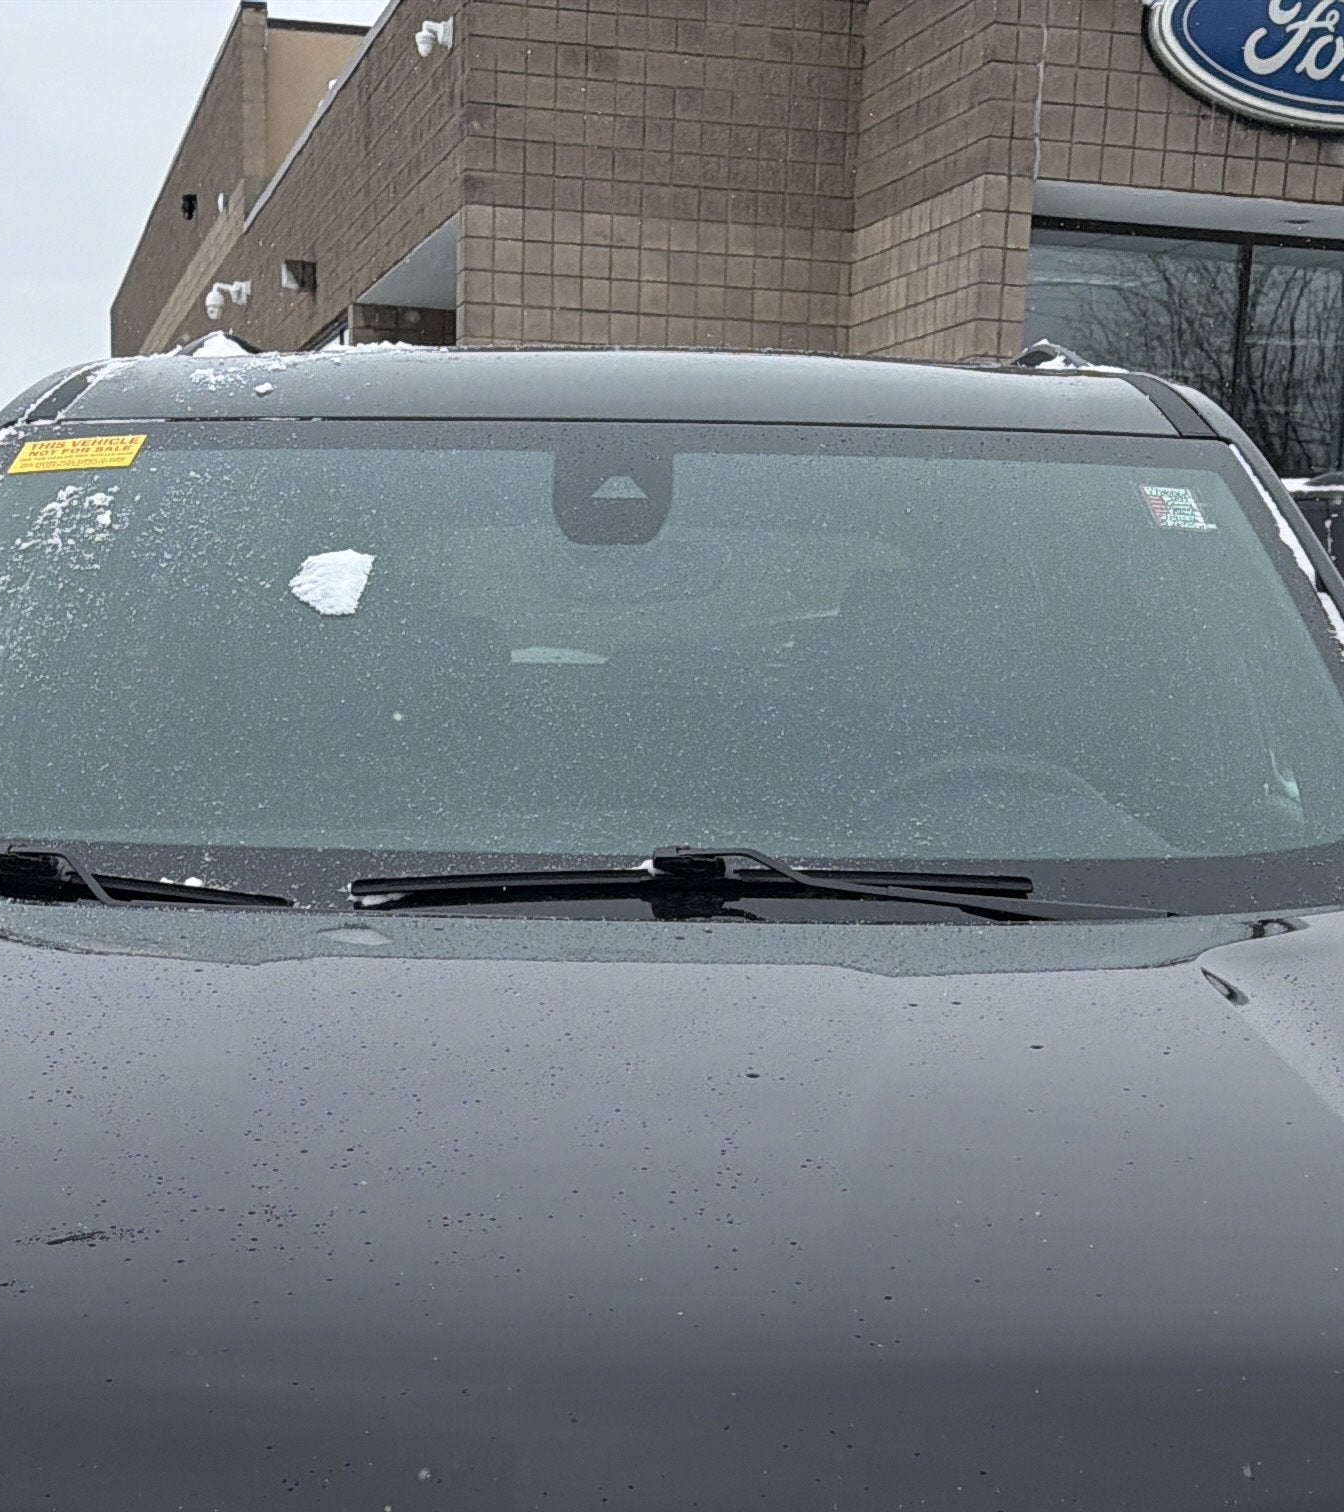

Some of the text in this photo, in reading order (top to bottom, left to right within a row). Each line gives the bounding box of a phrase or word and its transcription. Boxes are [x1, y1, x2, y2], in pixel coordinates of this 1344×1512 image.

[30, 437, 140, 451] THIS VEHICLE
[28, 449, 59, 457] NOT
[61, 447, 91, 455] FOR
[95, 445, 135, 453] SALE
